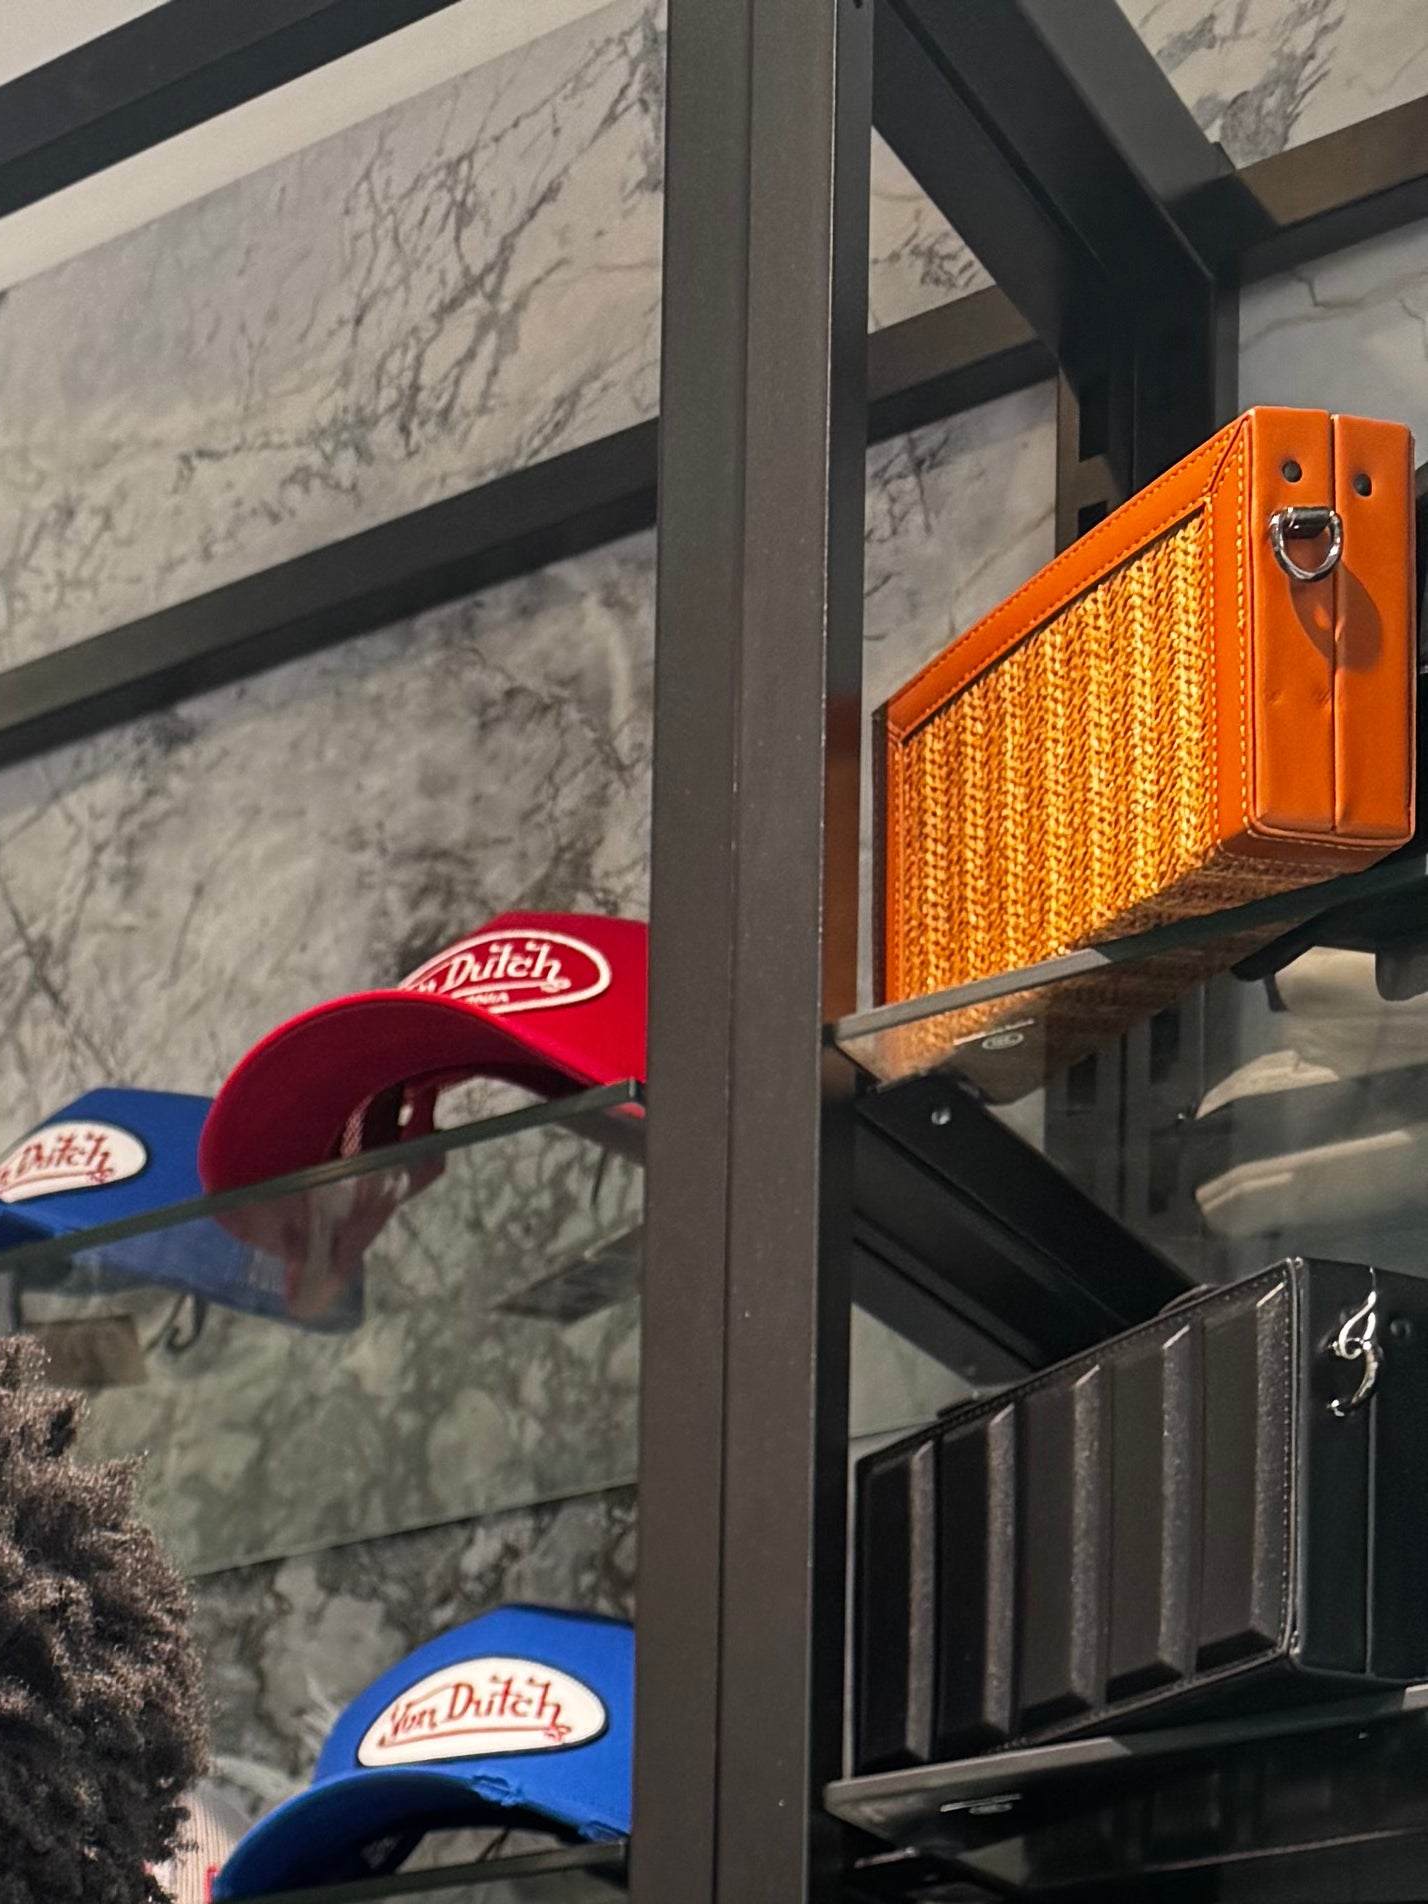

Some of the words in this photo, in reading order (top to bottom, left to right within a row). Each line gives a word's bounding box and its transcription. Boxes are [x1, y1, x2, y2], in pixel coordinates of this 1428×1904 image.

[439, 940, 571, 993] Dutch
[390, 1698, 440, 1738] Von
[441, 1675, 572, 1742] Dutch
